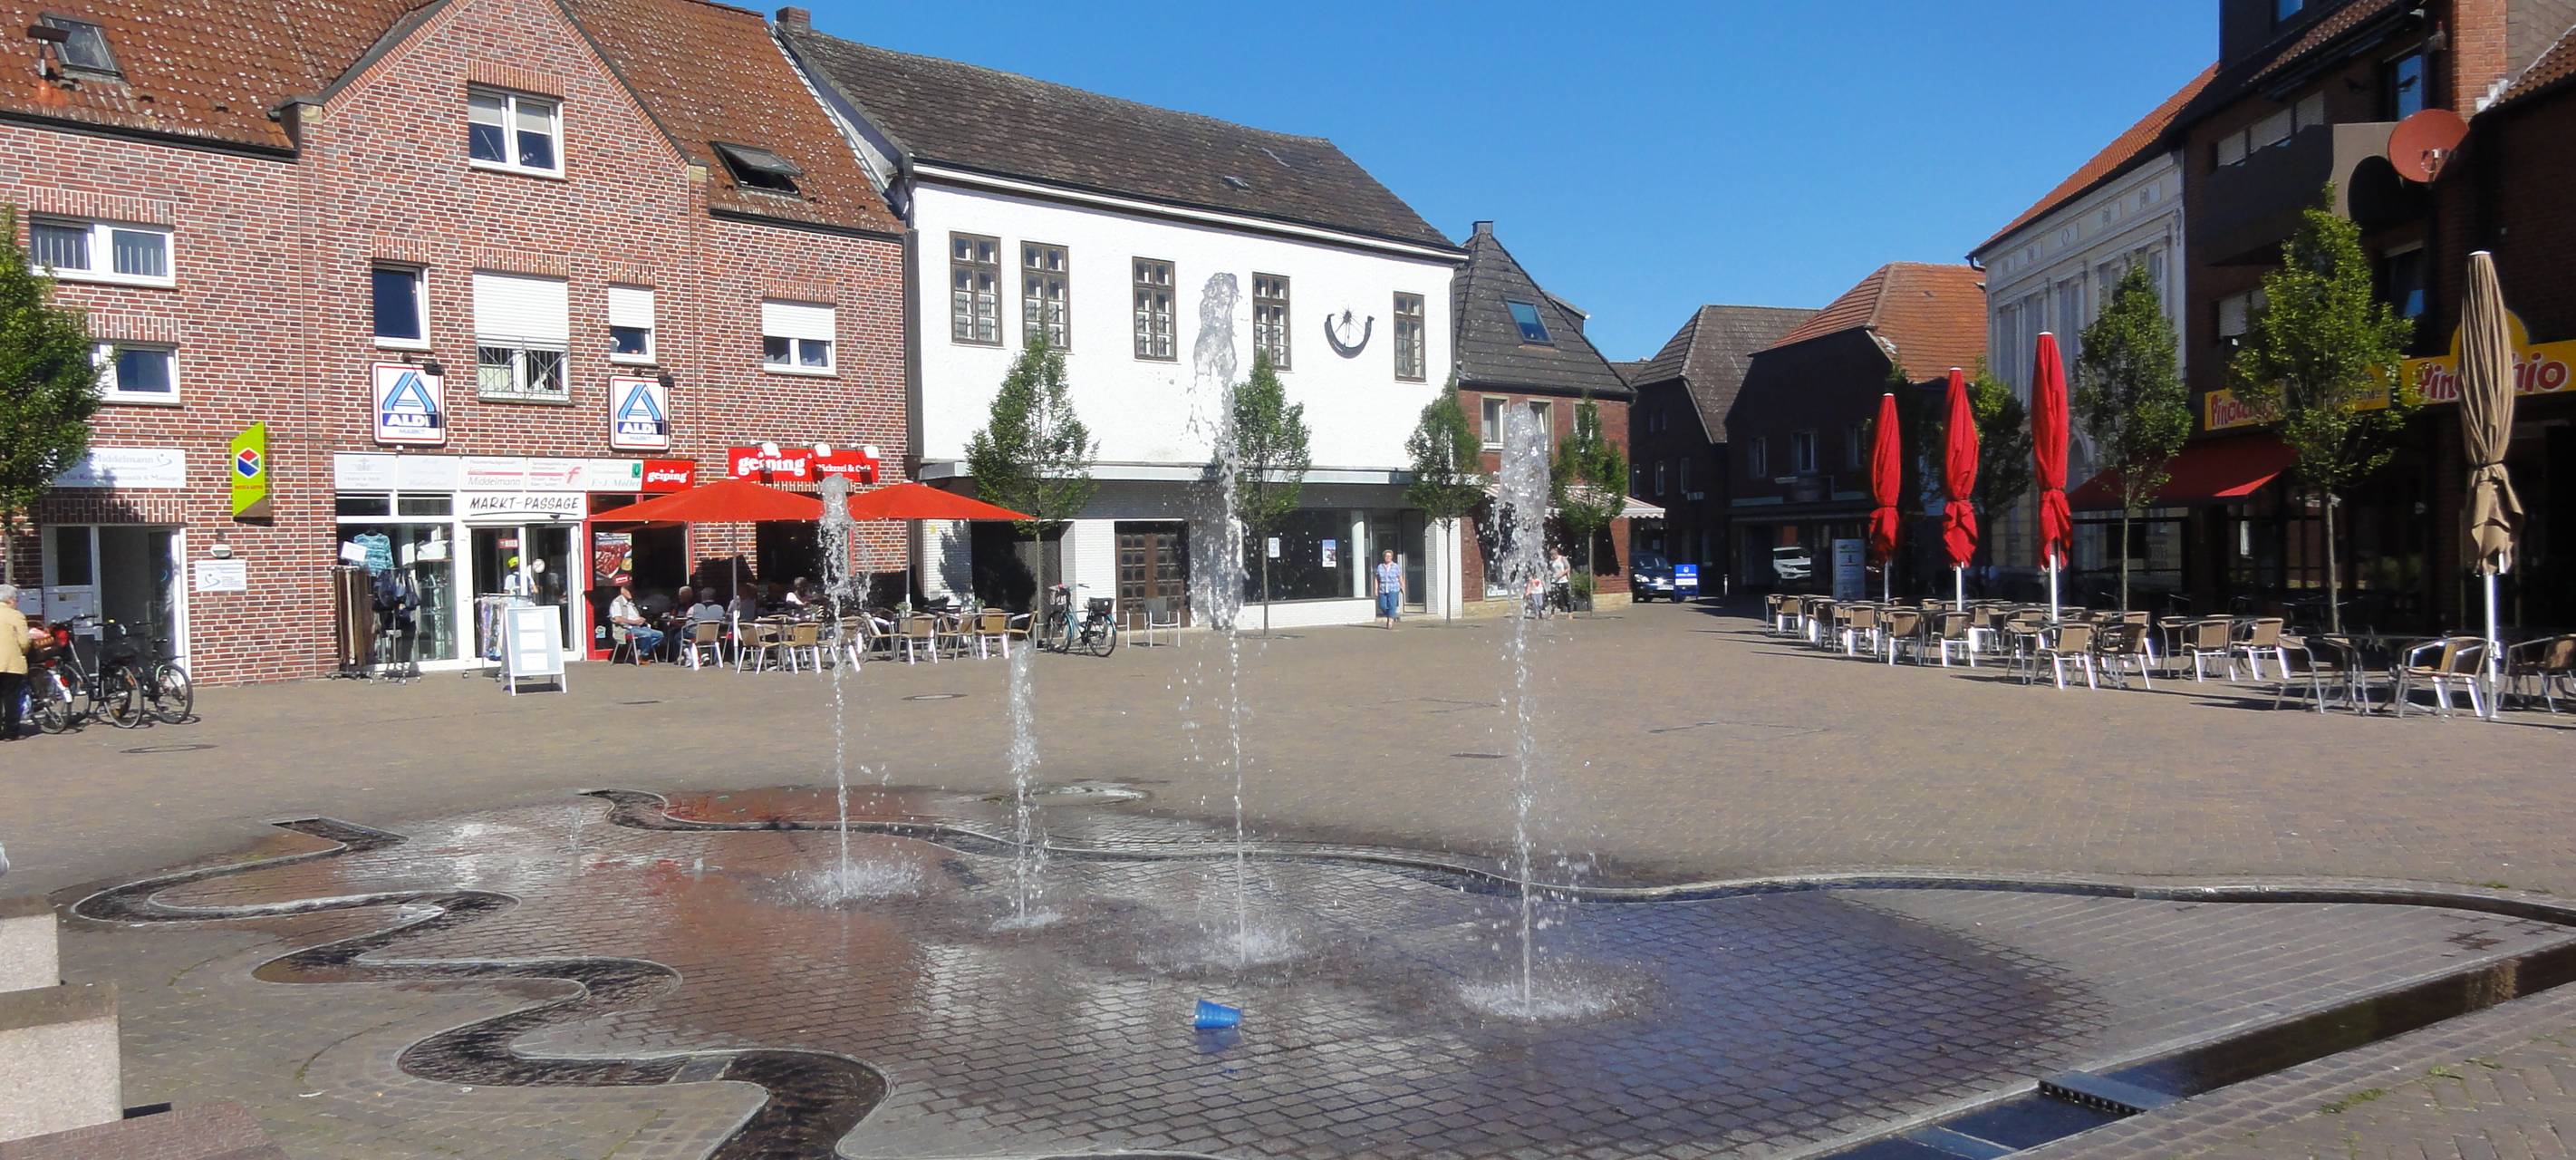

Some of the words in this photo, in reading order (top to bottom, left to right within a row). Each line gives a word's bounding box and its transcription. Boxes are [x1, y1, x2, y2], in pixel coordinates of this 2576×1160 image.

[387, 414, 430, 427] ALDI
[621, 422, 658, 434] ALDI
[738, 451, 806, 476] geiping
[468, 477, 521, 487] Middelmann
[647, 469, 688, 483] geiping
[470, 497, 579, 509] MARKT-PASSAGE
